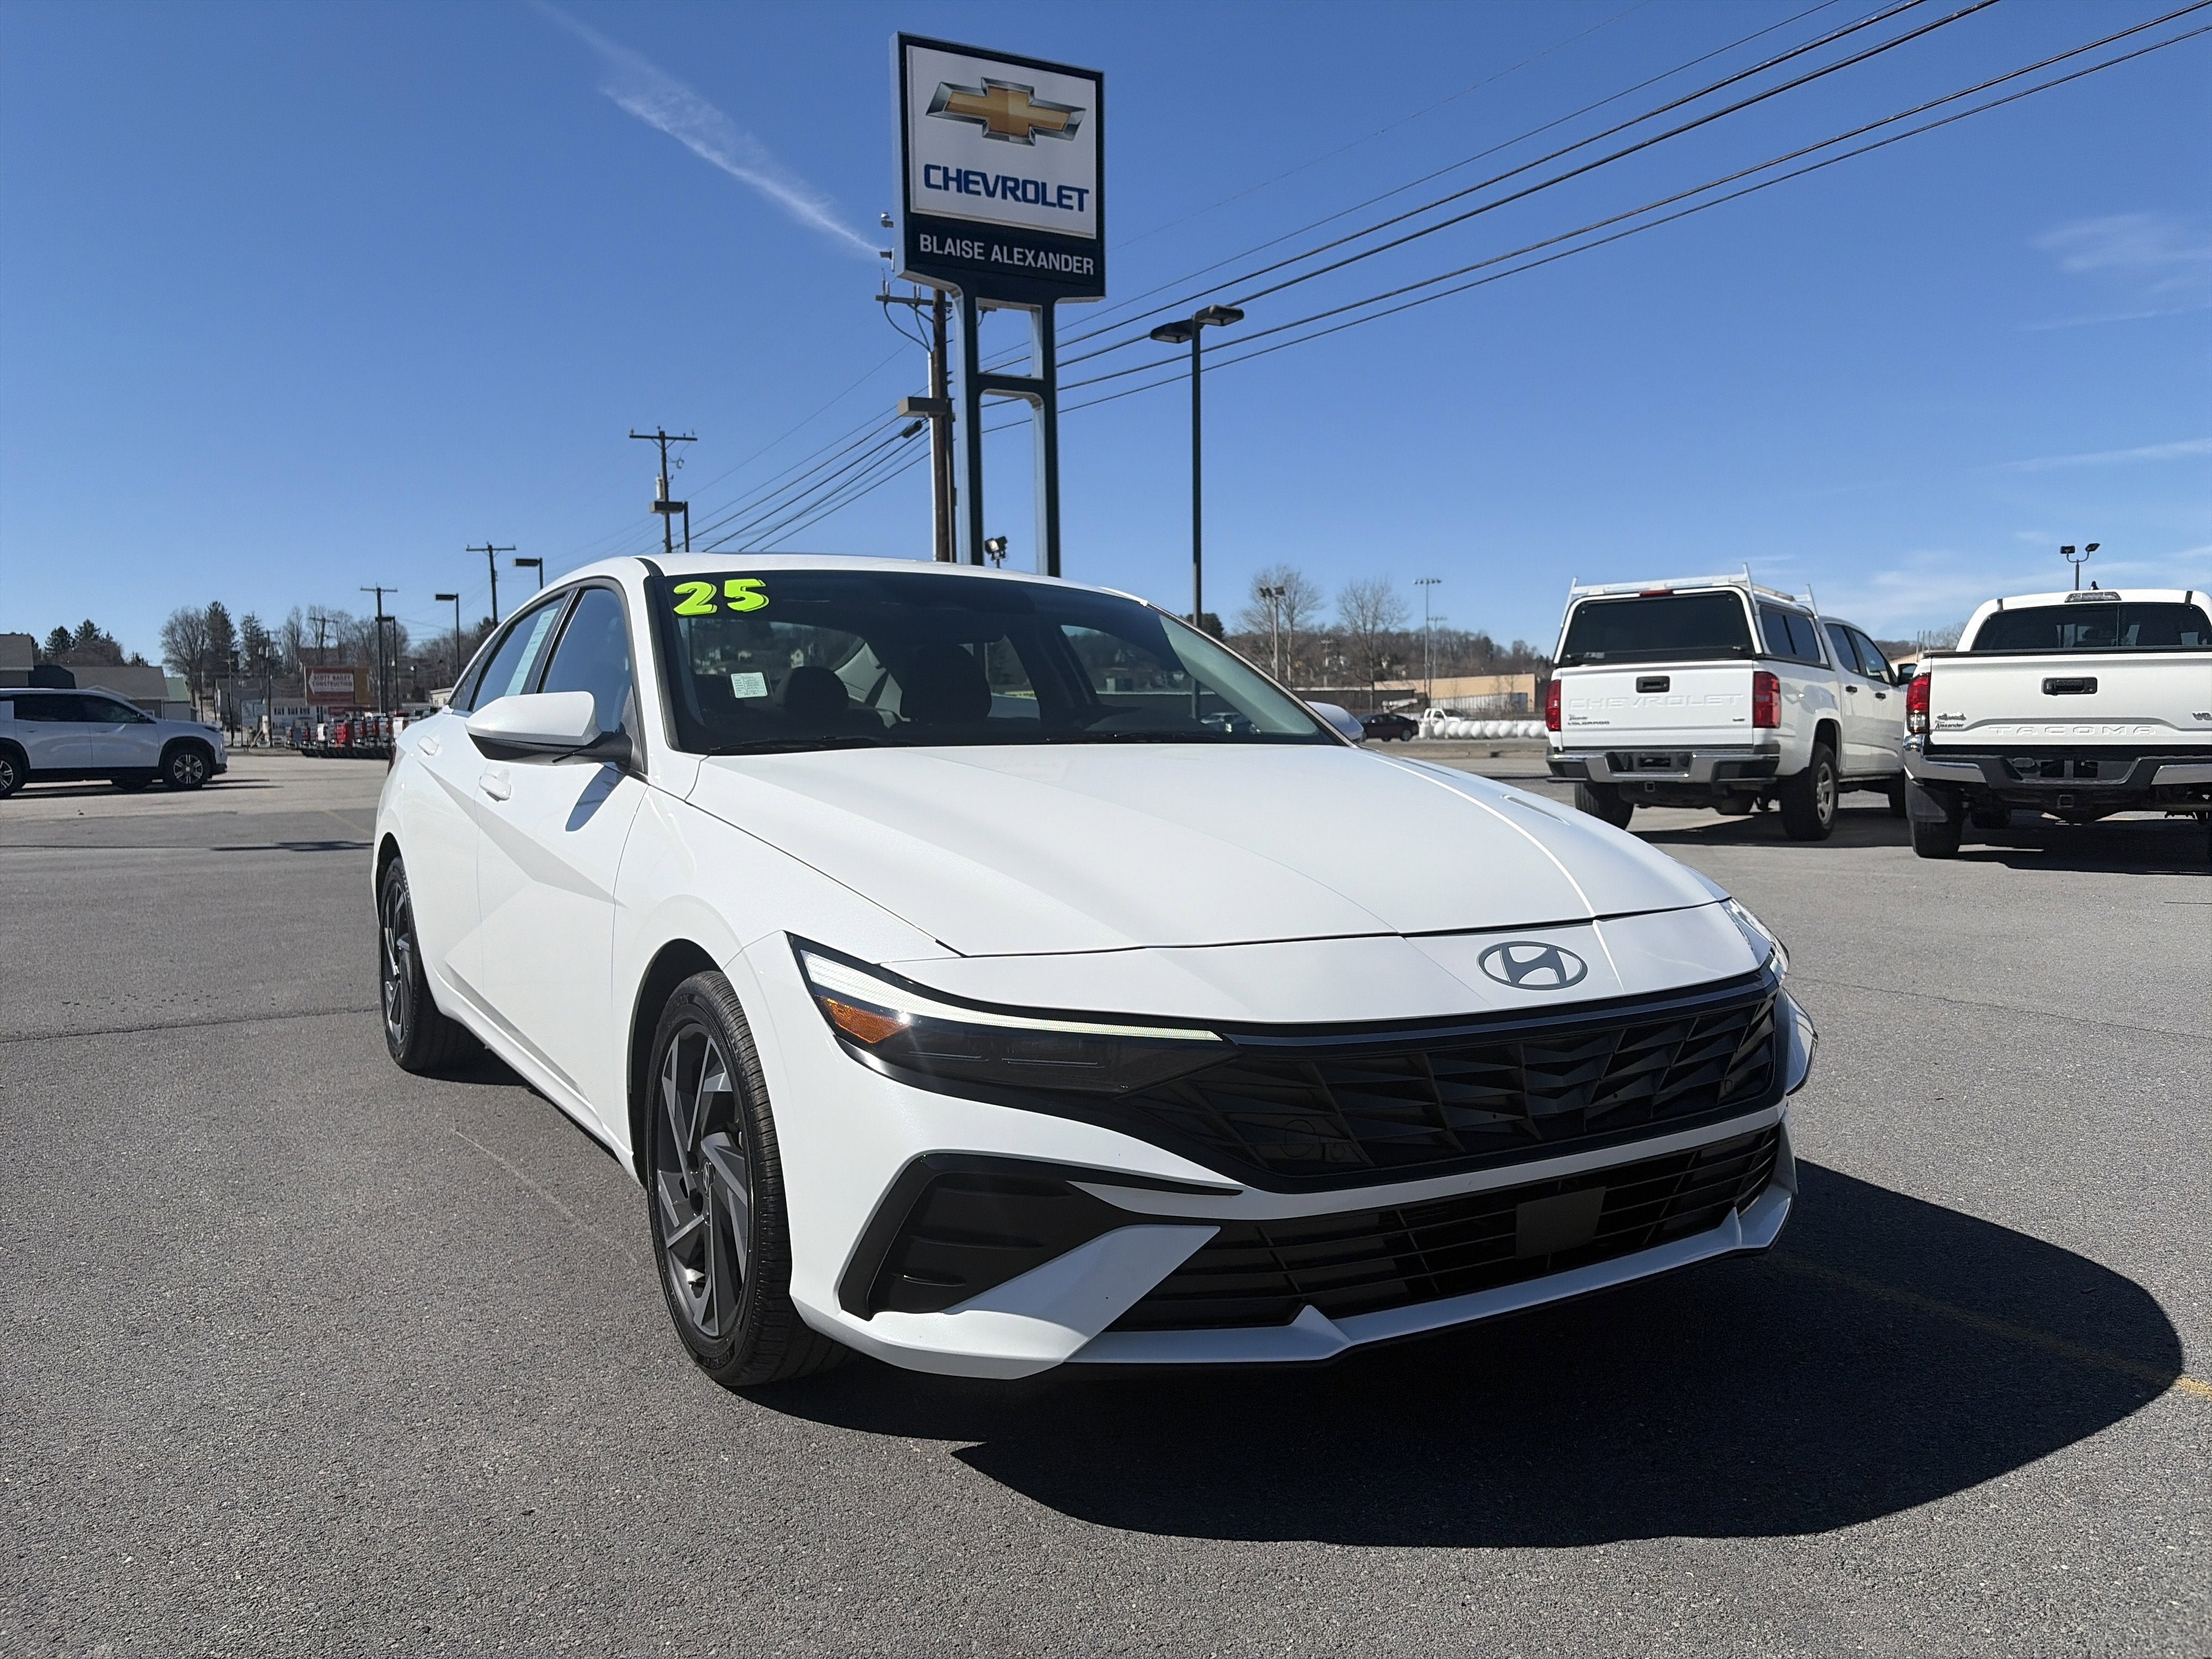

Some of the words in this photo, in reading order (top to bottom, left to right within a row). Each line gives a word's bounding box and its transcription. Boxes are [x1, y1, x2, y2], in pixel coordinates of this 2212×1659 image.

[924, 163, 1090, 213] CHEVROLET
[919, 233, 985, 261] BLAISE
[990, 244, 1094, 275] ALEXANDER
[673, 578, 770, 616] 25
[1568, 693, 1743, 710] CHEVROLET
[1988, 726, 2157, 736] TACOMA
